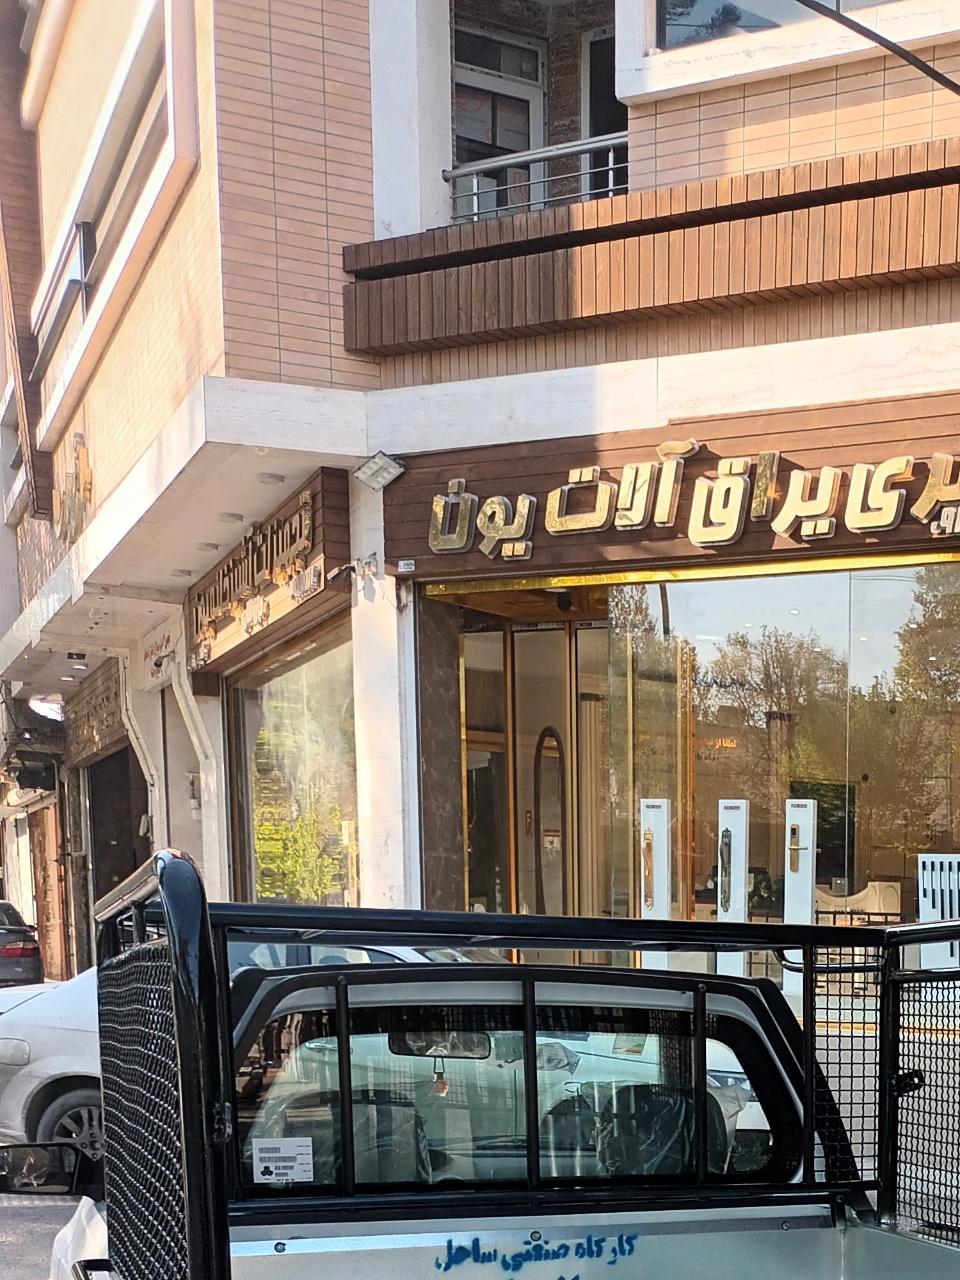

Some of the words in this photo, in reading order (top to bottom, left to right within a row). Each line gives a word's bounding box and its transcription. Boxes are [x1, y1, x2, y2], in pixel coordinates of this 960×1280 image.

[428, 478, 537, 561] یون
[545, 438, 699, 536] آلات
[687, 450, 841, 546] یراق
[435, 1237, 498, 1272] ساحل
